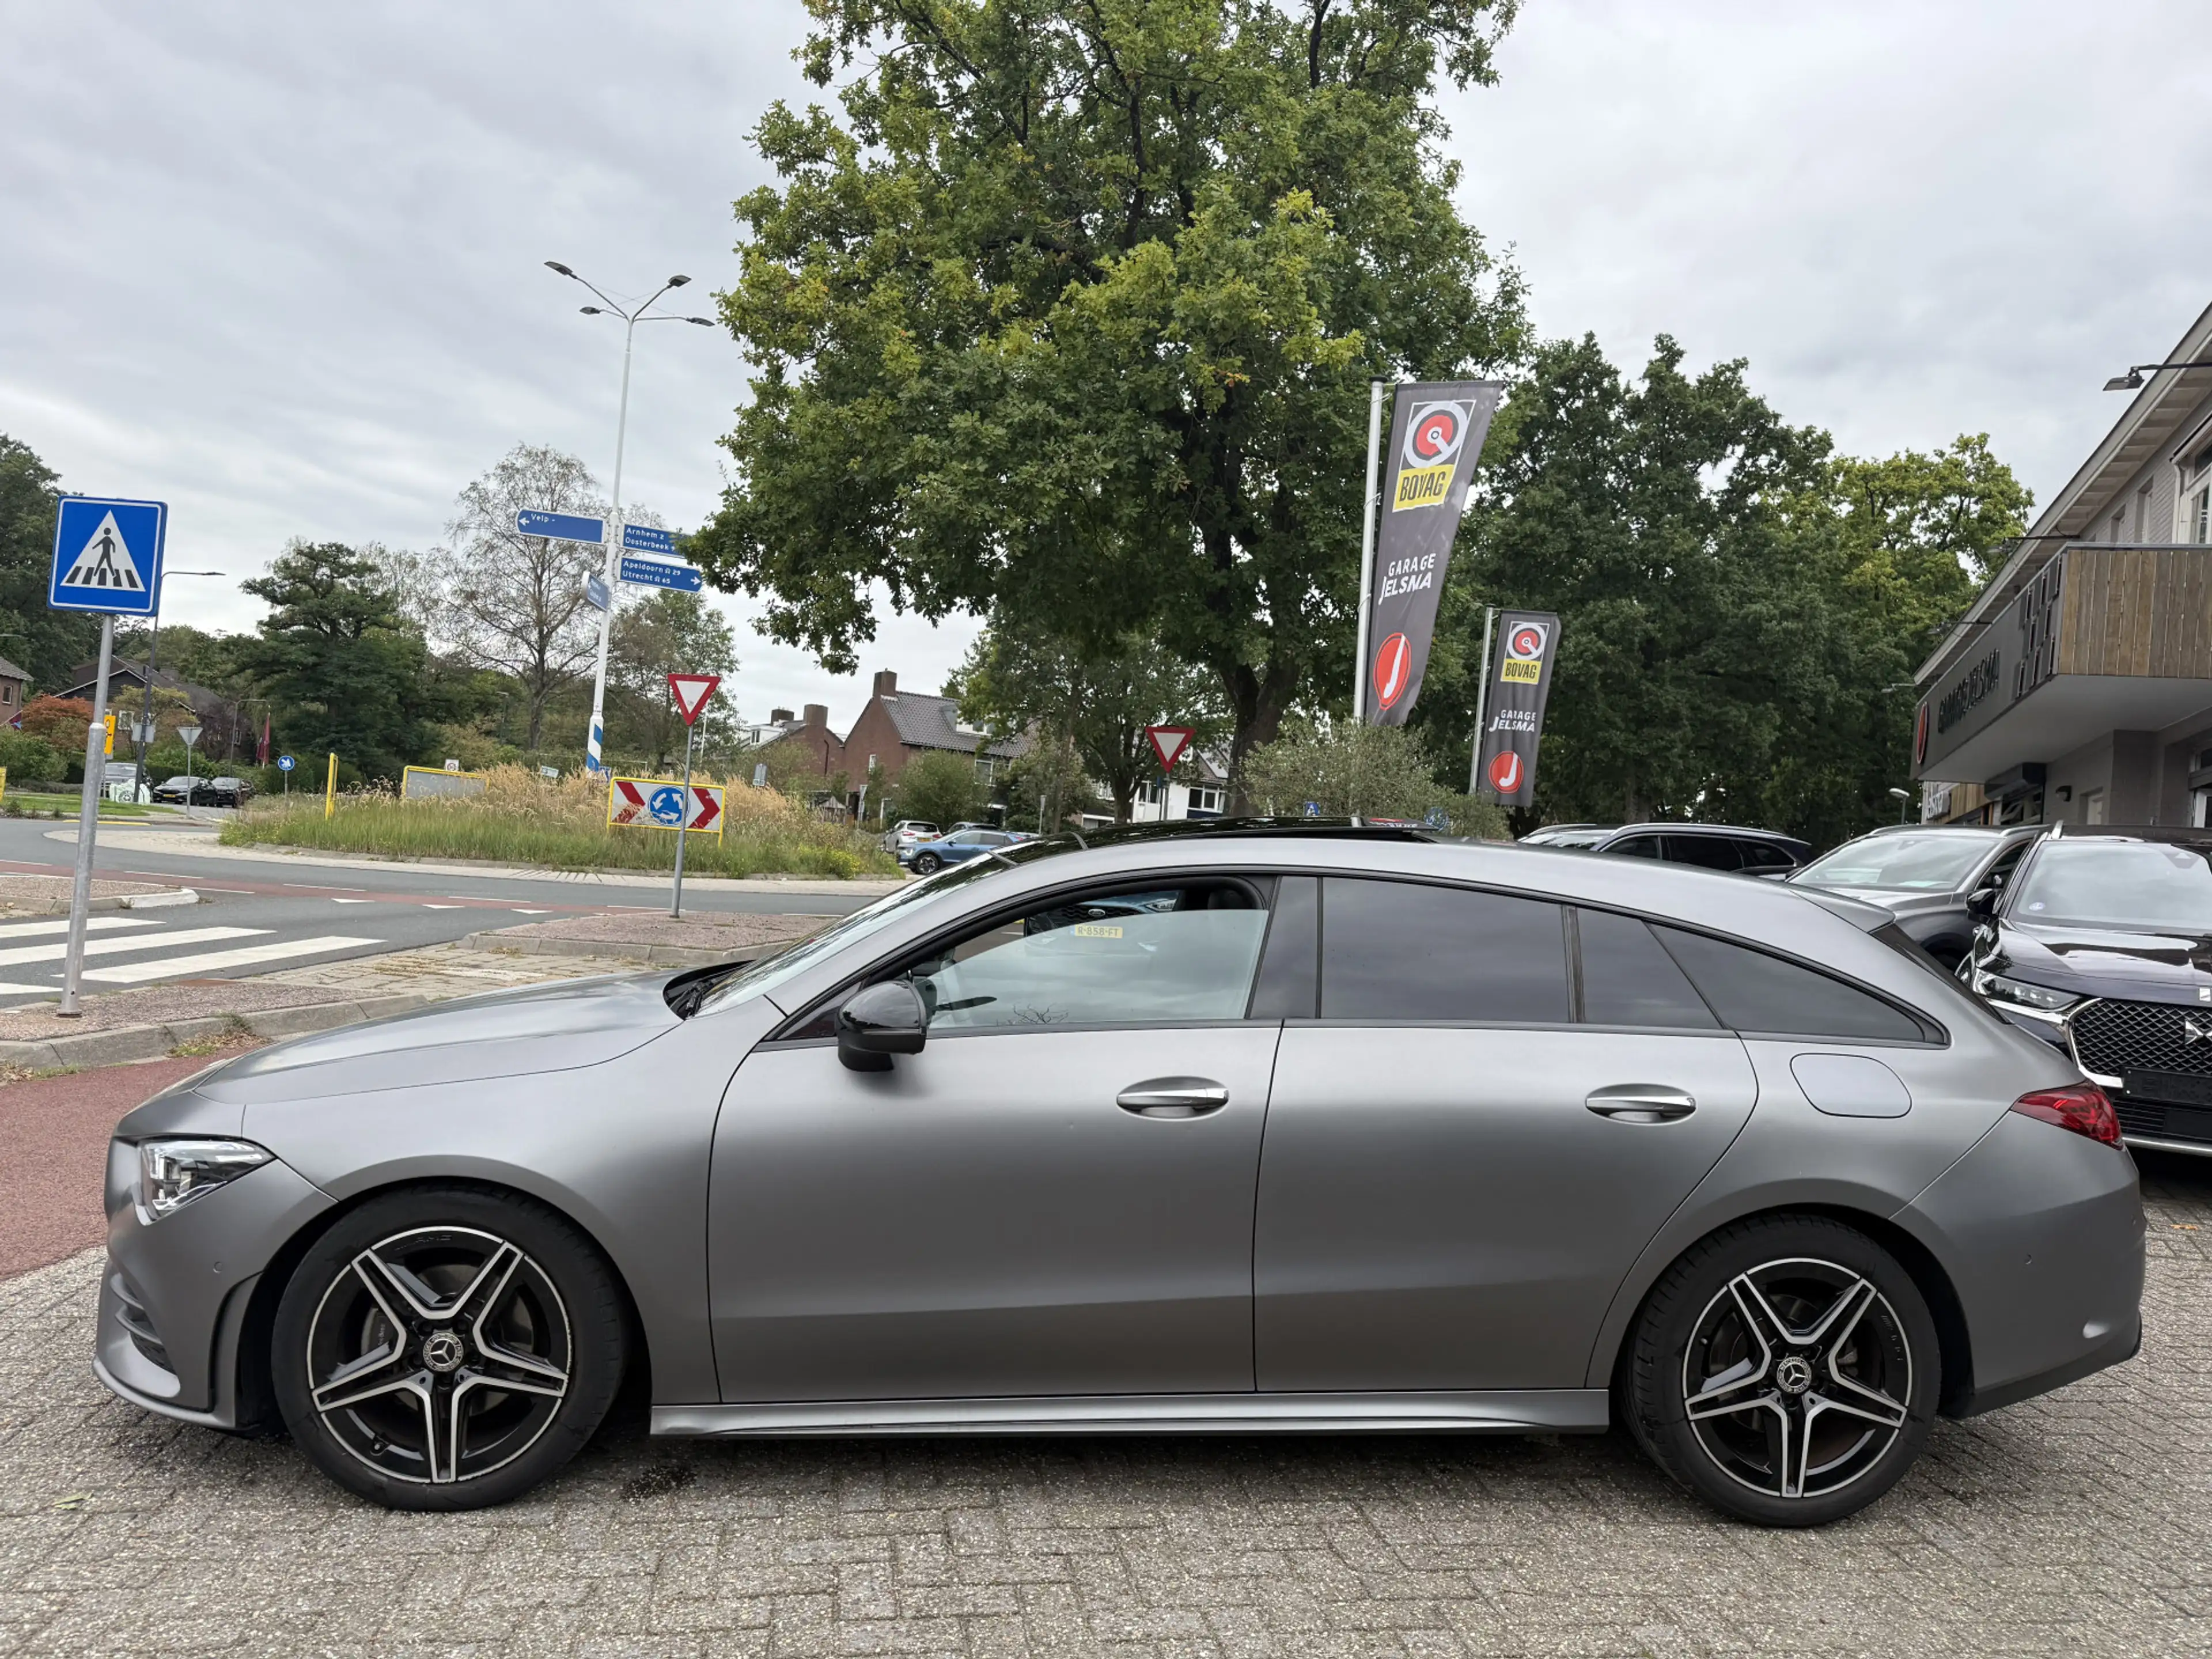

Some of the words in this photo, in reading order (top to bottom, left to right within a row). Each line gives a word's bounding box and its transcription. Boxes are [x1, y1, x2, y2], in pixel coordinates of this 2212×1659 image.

[1399, 471, 1446, 502] BOVAG
[531, 513, 549, 523] Velp
[626, 527, 657, 539] Arnhem
[625, 537, 669, 551] Oosterbeek
[623, 560, 664, 573] Apeldoorn
[1388, 552, 1436, 577] GARAGE
[622, 570, 653, 581] Utrecht
[1378, 571, 1432, 605] JELSMA
[1505, 662, 1537, 679] BOVAG
[1501, 709, 1536, 721] GARAGE
[1488, 716, 1535, 732] JELSMA
